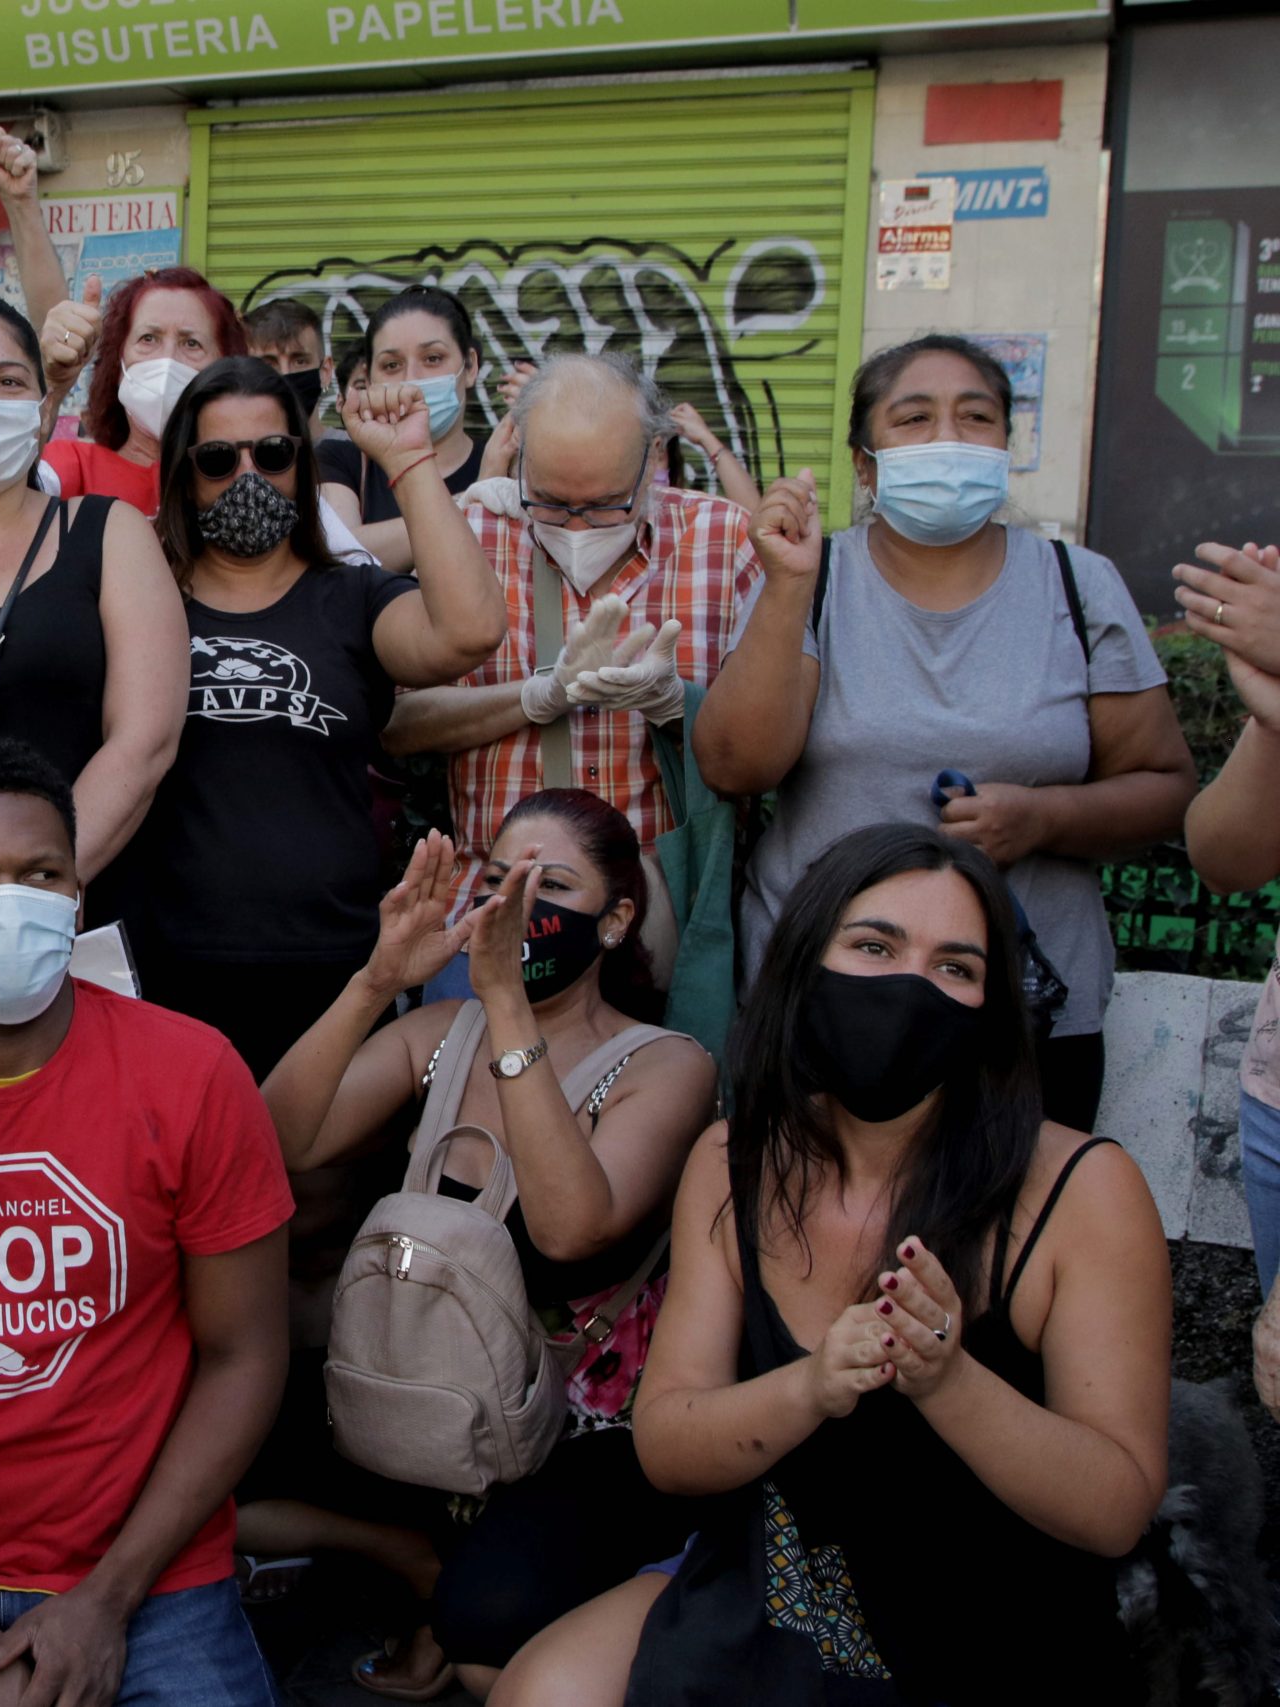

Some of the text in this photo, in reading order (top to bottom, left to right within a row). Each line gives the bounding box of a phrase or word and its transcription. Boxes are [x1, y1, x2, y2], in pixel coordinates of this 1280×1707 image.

[25, 0, 624, 69] BISUTERIA PAPELERIA
[106, 149, 145, 187] 95
[48, 200, 177, 234] RETERIA
[882, 228, 950, 244] Alarma
[202, 687, 307, 716] AVPS
[526, 914, 561, 939] LM
[522, 957, 557, 982] NCE
